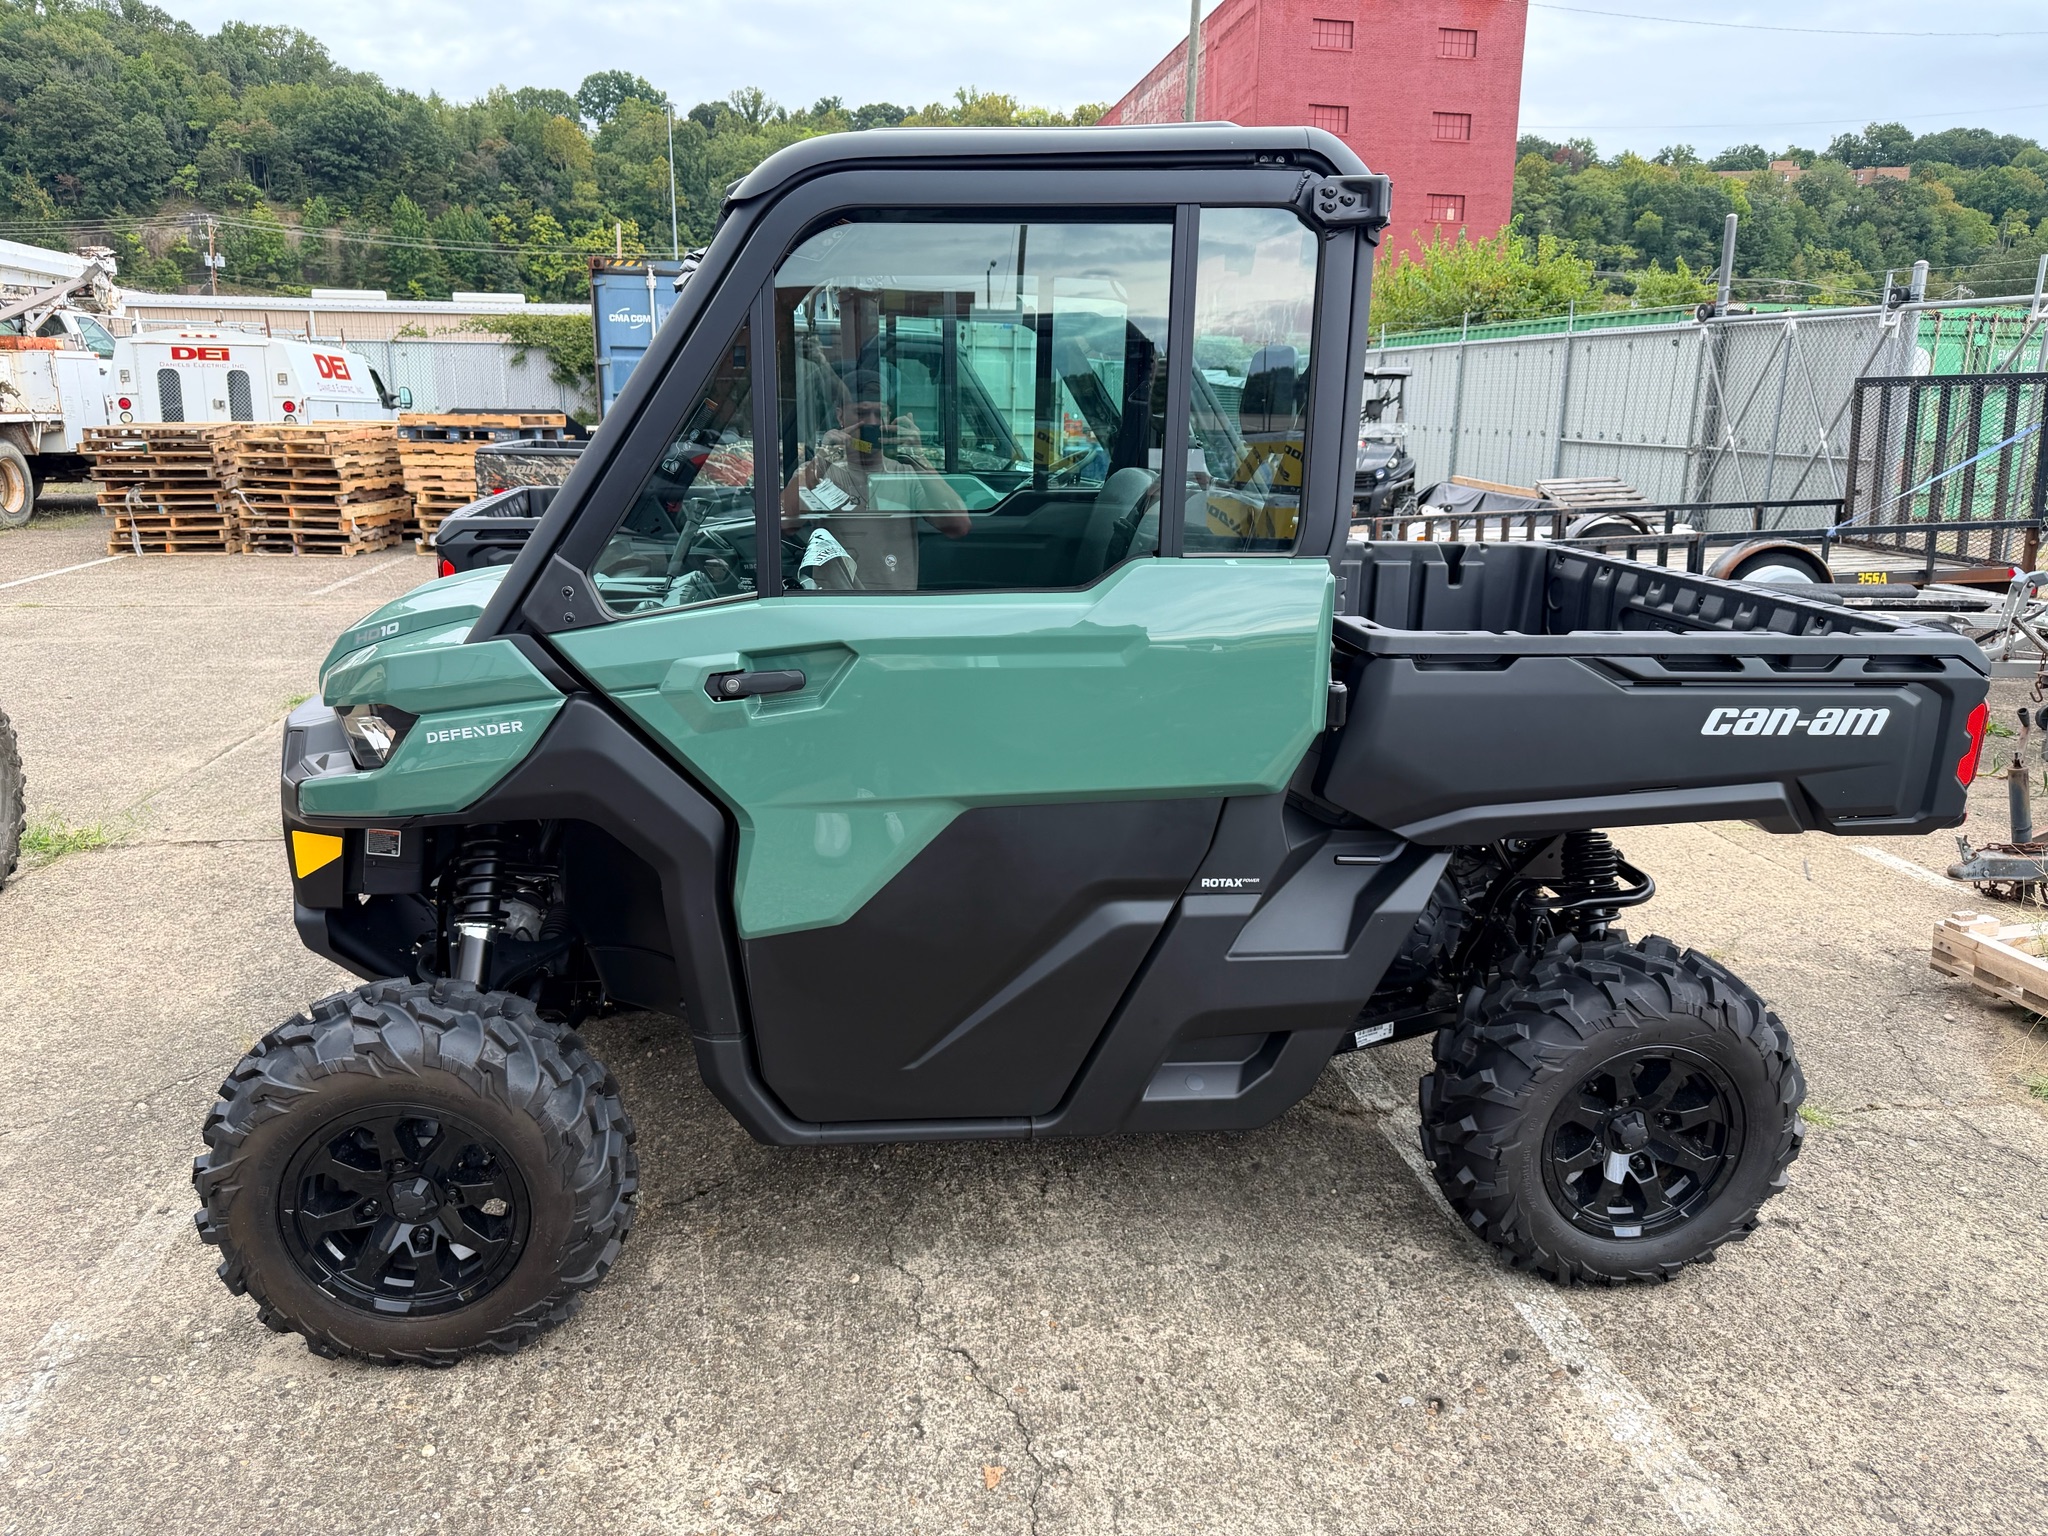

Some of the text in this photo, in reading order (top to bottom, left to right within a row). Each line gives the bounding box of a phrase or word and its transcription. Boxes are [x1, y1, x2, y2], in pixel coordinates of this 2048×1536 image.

[608, 313, 651, 323] CMA CGM
[355, 621, 400, 644] HD10
[426, 720, 524, 744] DEFENDER
[1700, 707, 1891, 736] can-am
[1201, 878, 1243, 888] ROTAX
